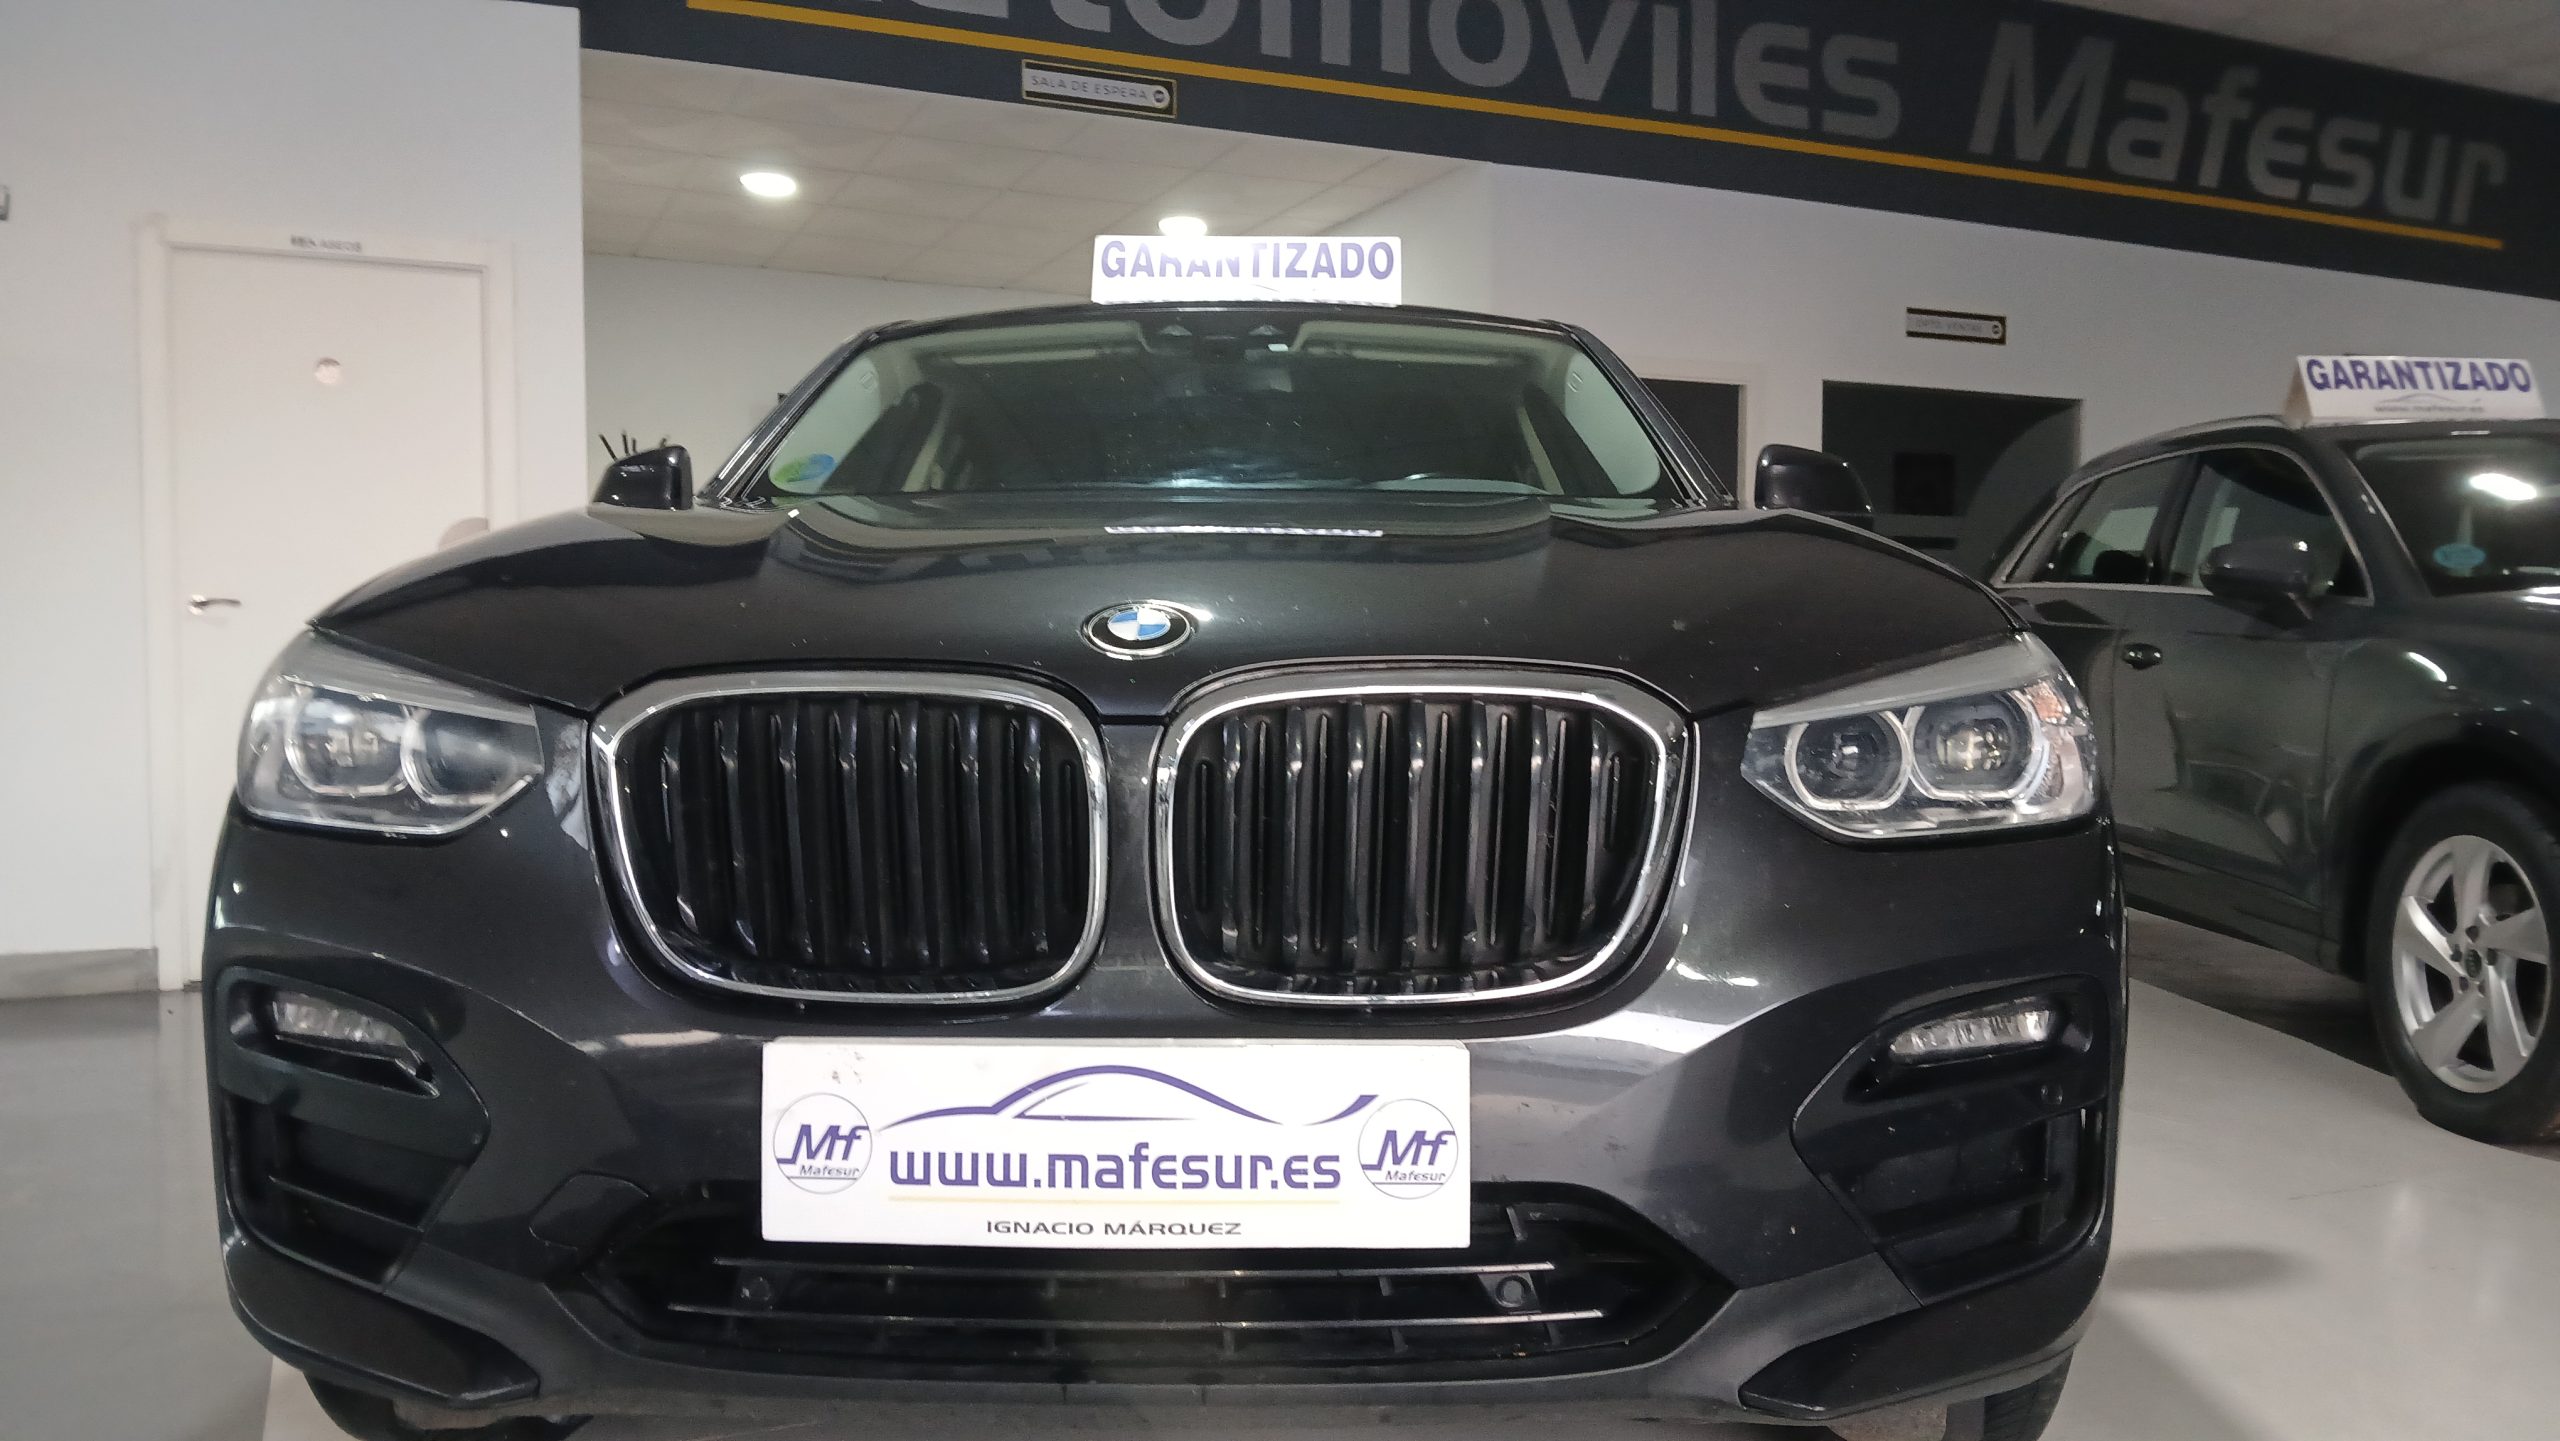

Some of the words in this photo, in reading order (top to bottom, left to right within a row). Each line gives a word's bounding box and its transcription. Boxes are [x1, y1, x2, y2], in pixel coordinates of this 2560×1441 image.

[1031, 75, 1067, 89] SALA
[1071, 80, 1089, 92] DE
[1094, 84, 1148, 99] ESPERA
[1968, 20, 2506, 225] Mafesur
[1101, 240, 1394, 279] GARANTIZADO
[2306, 358, 2531, 393] GARANTIZADO
[800, 1164, 860, 1177] Mafesur
[890, 1142, 1341, 1190] www.mafesur.es
[1385, 1170, 1446, 1182] Mafesur
[986, 1221, 1094, 1236] IGNACIO
[1104, 1219, 1242, 1236] MÁRQUEZ
